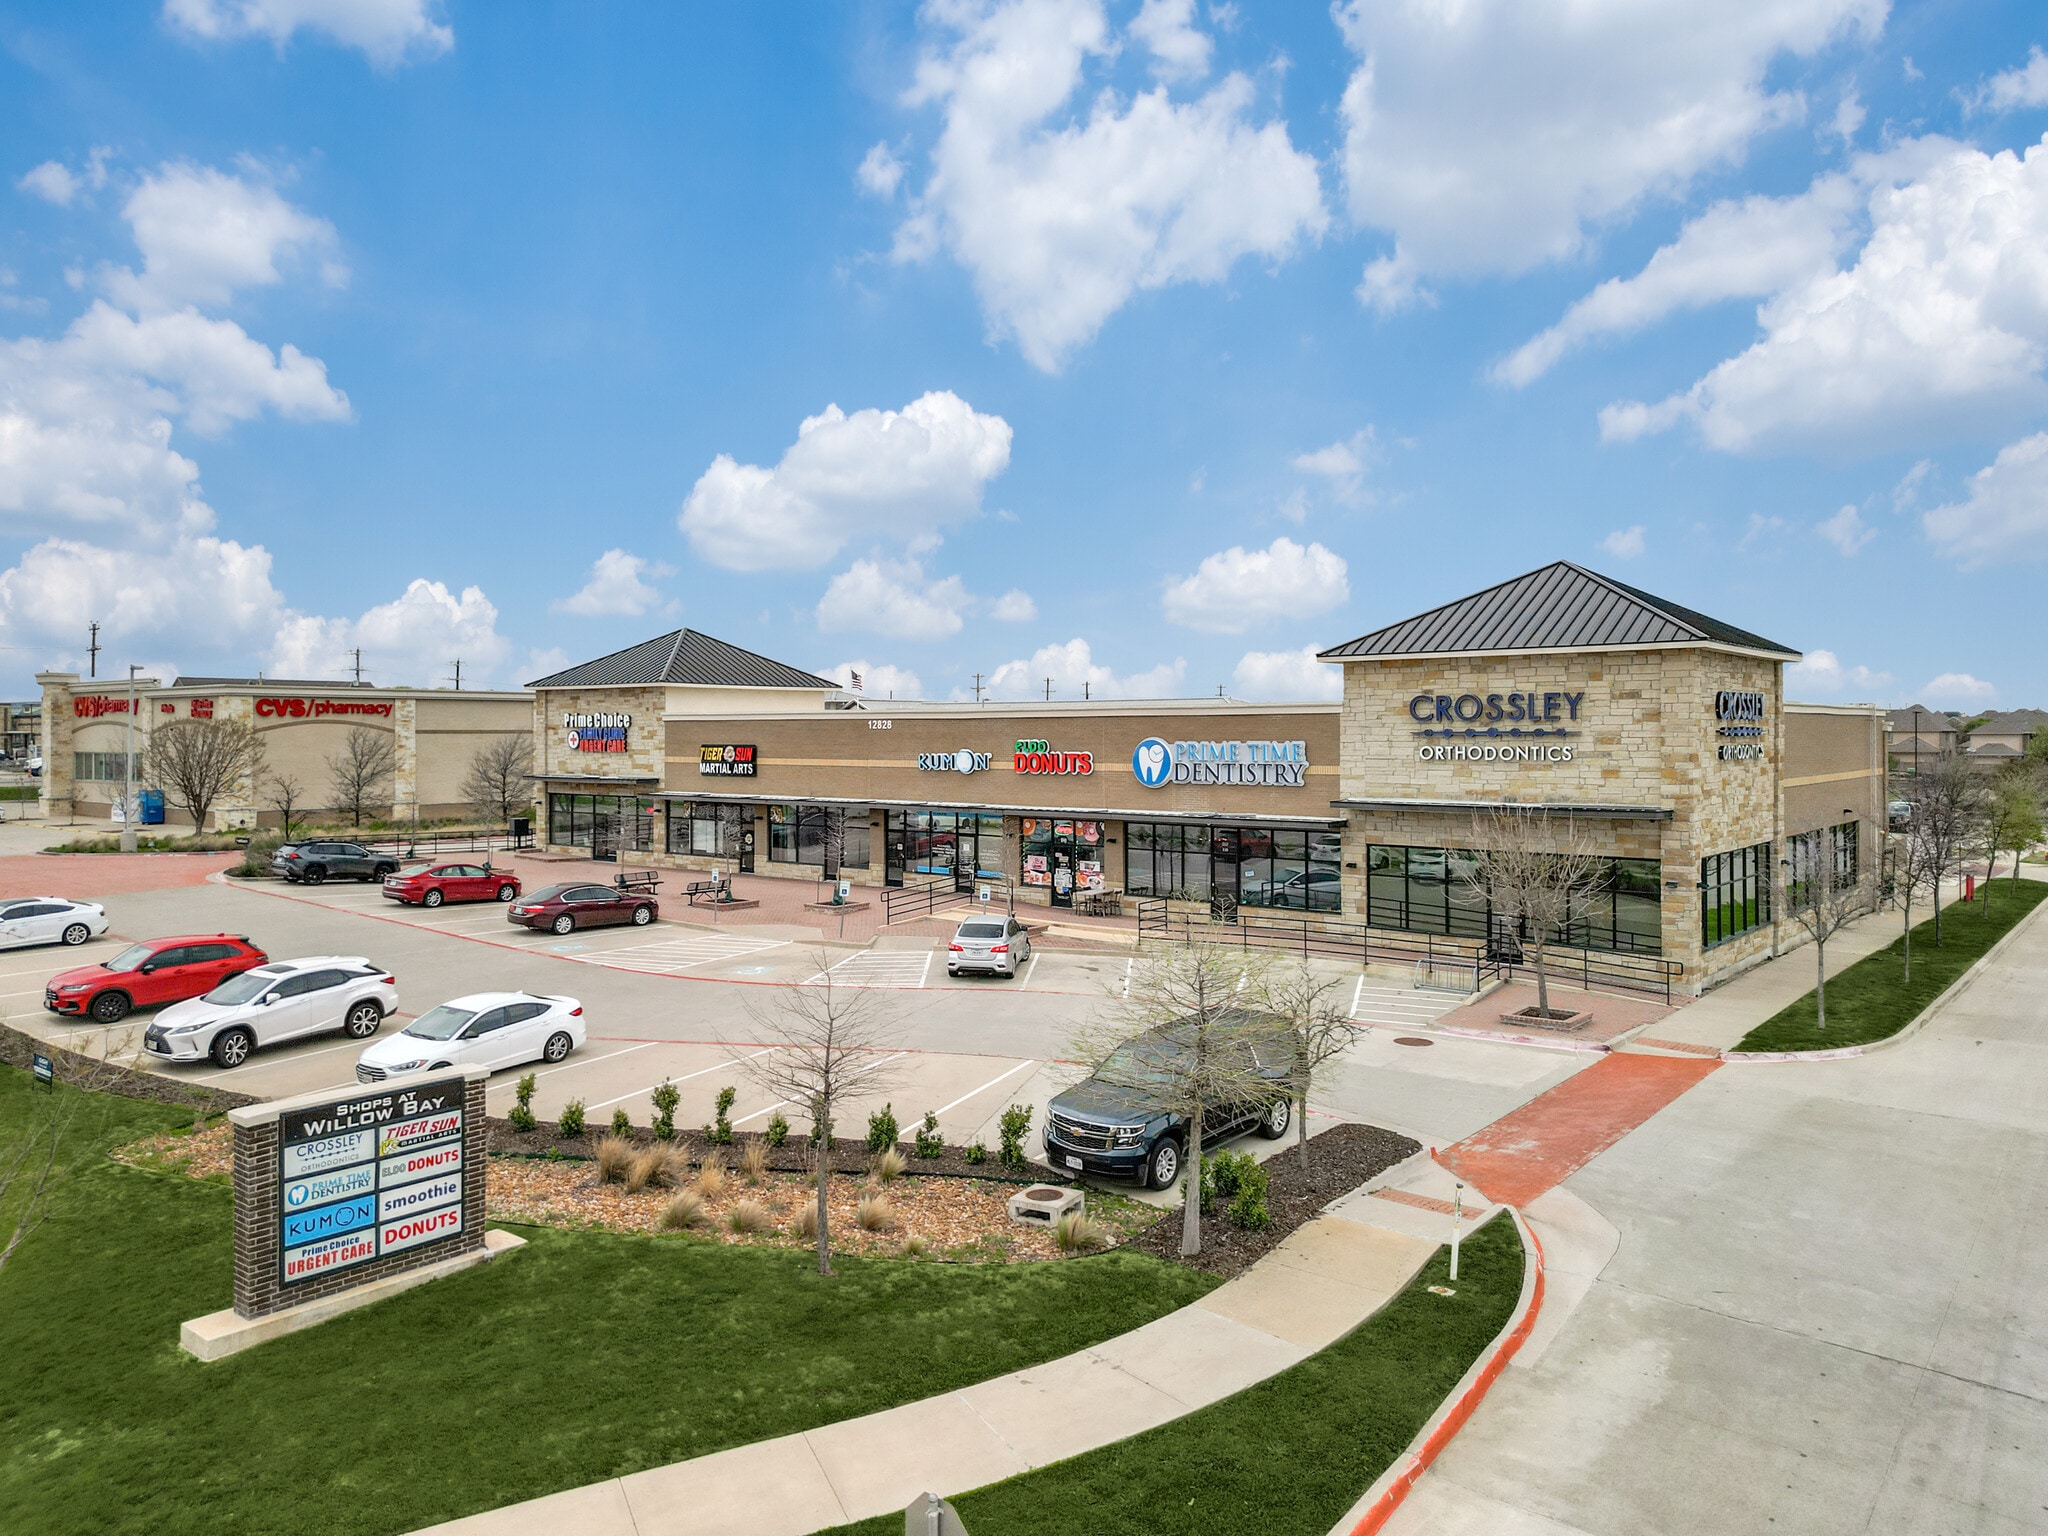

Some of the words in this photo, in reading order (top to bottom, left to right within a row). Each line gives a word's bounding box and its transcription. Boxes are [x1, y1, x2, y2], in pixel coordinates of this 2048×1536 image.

[255, 698, 393, 718] CVS/pharmacy
[1409, 692, 1585, 722] CROSSLEY
[564, 713, 593, 728] Prime
[594, 712, 631, 728] Choice
[868, 720, 892, 730] 12828
[700, 747, 723, 761] TIGER
[735, 747, 753, 761] SUN
[917, 749, 989, 774] KUMON
[1014, 752, 1092, 774] DONUTS
[1175, 743, 1240, 762] PRIME
[1247, 743, 1304, 762] TIME
[1419, 745, 1573, 762] ORTHODONTICS
[699, 762, 732, 774] MARTIAL
[733, 763, 754, 775] ARTS
[1174, 763, 1307, 784] DENTISTRY
[386, 1120, 429, 1139] TIGER
[429, 1116, 459, 1133] SUN
[438, 1129, 457, 1138] ARTS
[296, 1133, 363, 1157] CROSSLEY
[300, 1153, 360, 1173] ORTHODONTICS
[382, 1163, 406, 1178] ELDO
[408, 1149, 459, 1172] DONUTS
[311, 1176, 343, 1191] PRIME
[346, 1170, 371, 1183] TIME
[311, 1176, 371, 1200] DENTISTRY
[384, 1182, 457, 1211] smoothie
[290, 1204, 370, 1237] KUMON
[385, 1210, 458, 1245] DONUTS
[302, 1244, 328, 1257] Prime
[329, 1236, 360, 1250] Choice
[287, 1250, 338, 1275] URGENT
[341, 1241, 373, 1261] CARE
